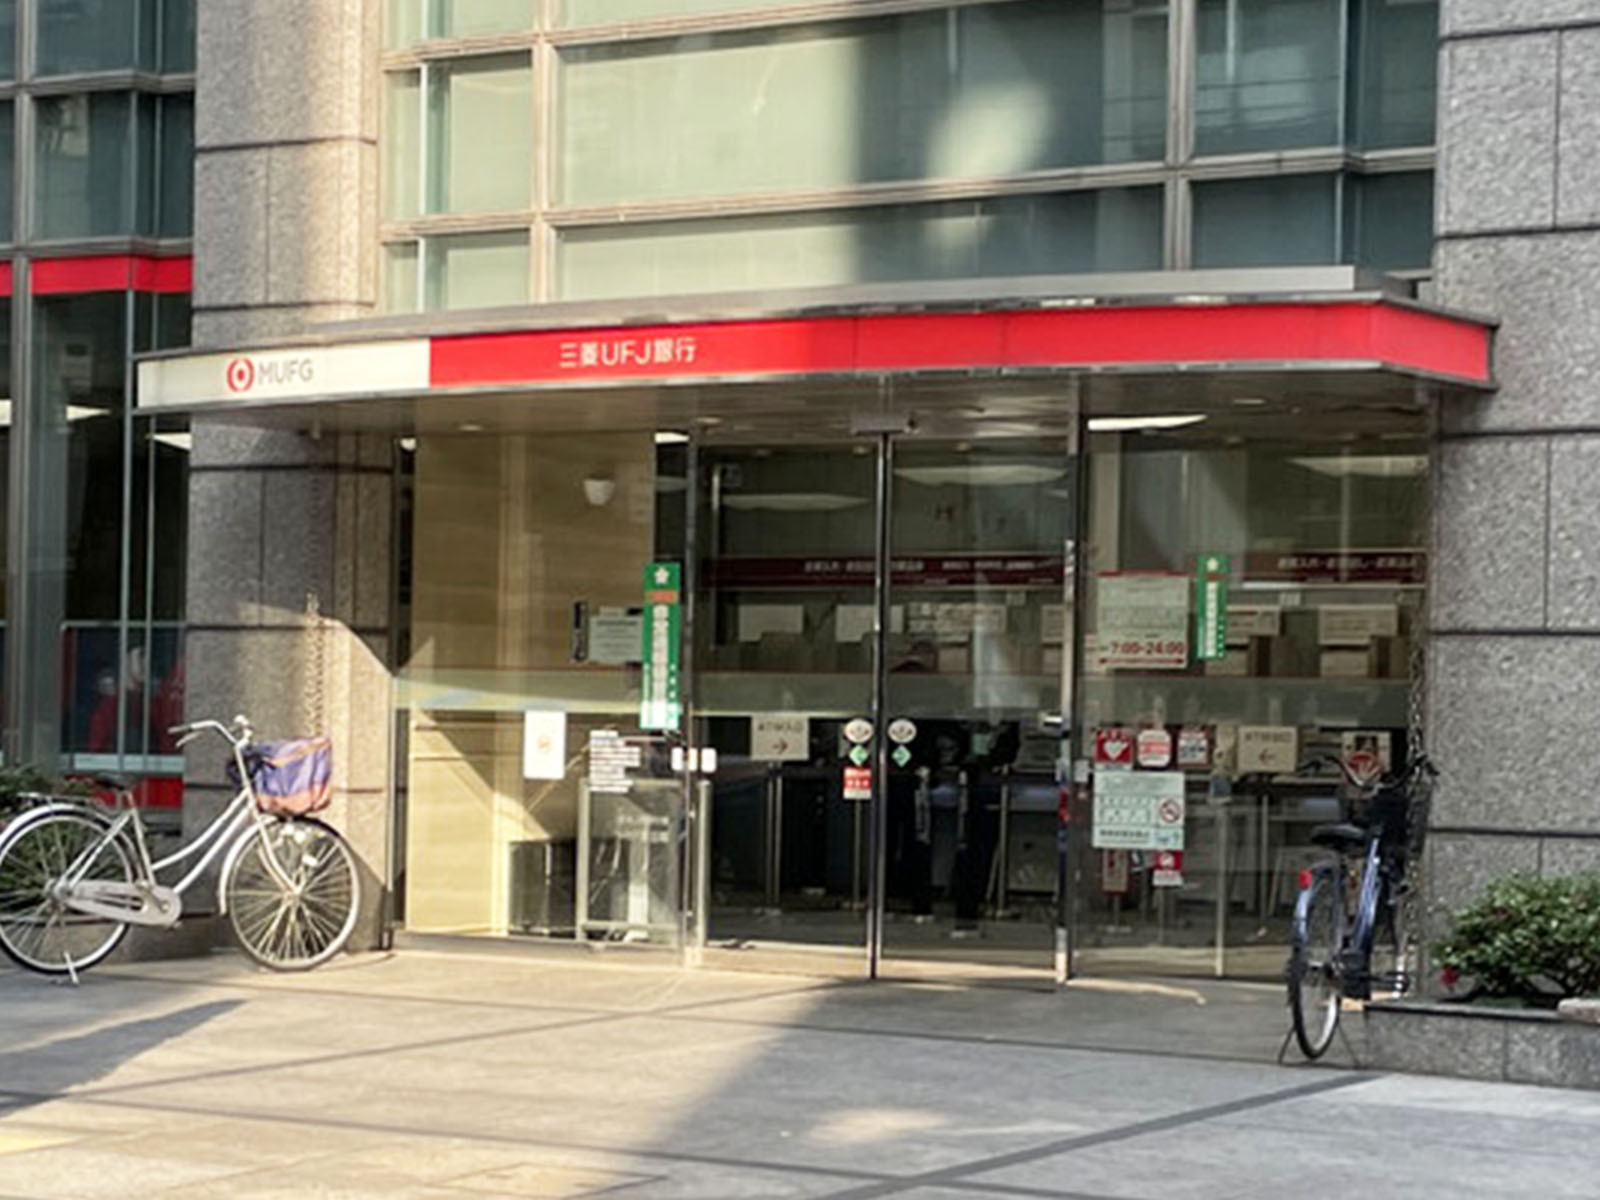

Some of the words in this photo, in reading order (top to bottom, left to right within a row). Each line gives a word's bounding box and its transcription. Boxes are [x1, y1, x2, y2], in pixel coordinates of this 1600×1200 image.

[559, 336, 697, 369] 三菱UFJ銀行
[257, 357, 314, 385] MUFG
